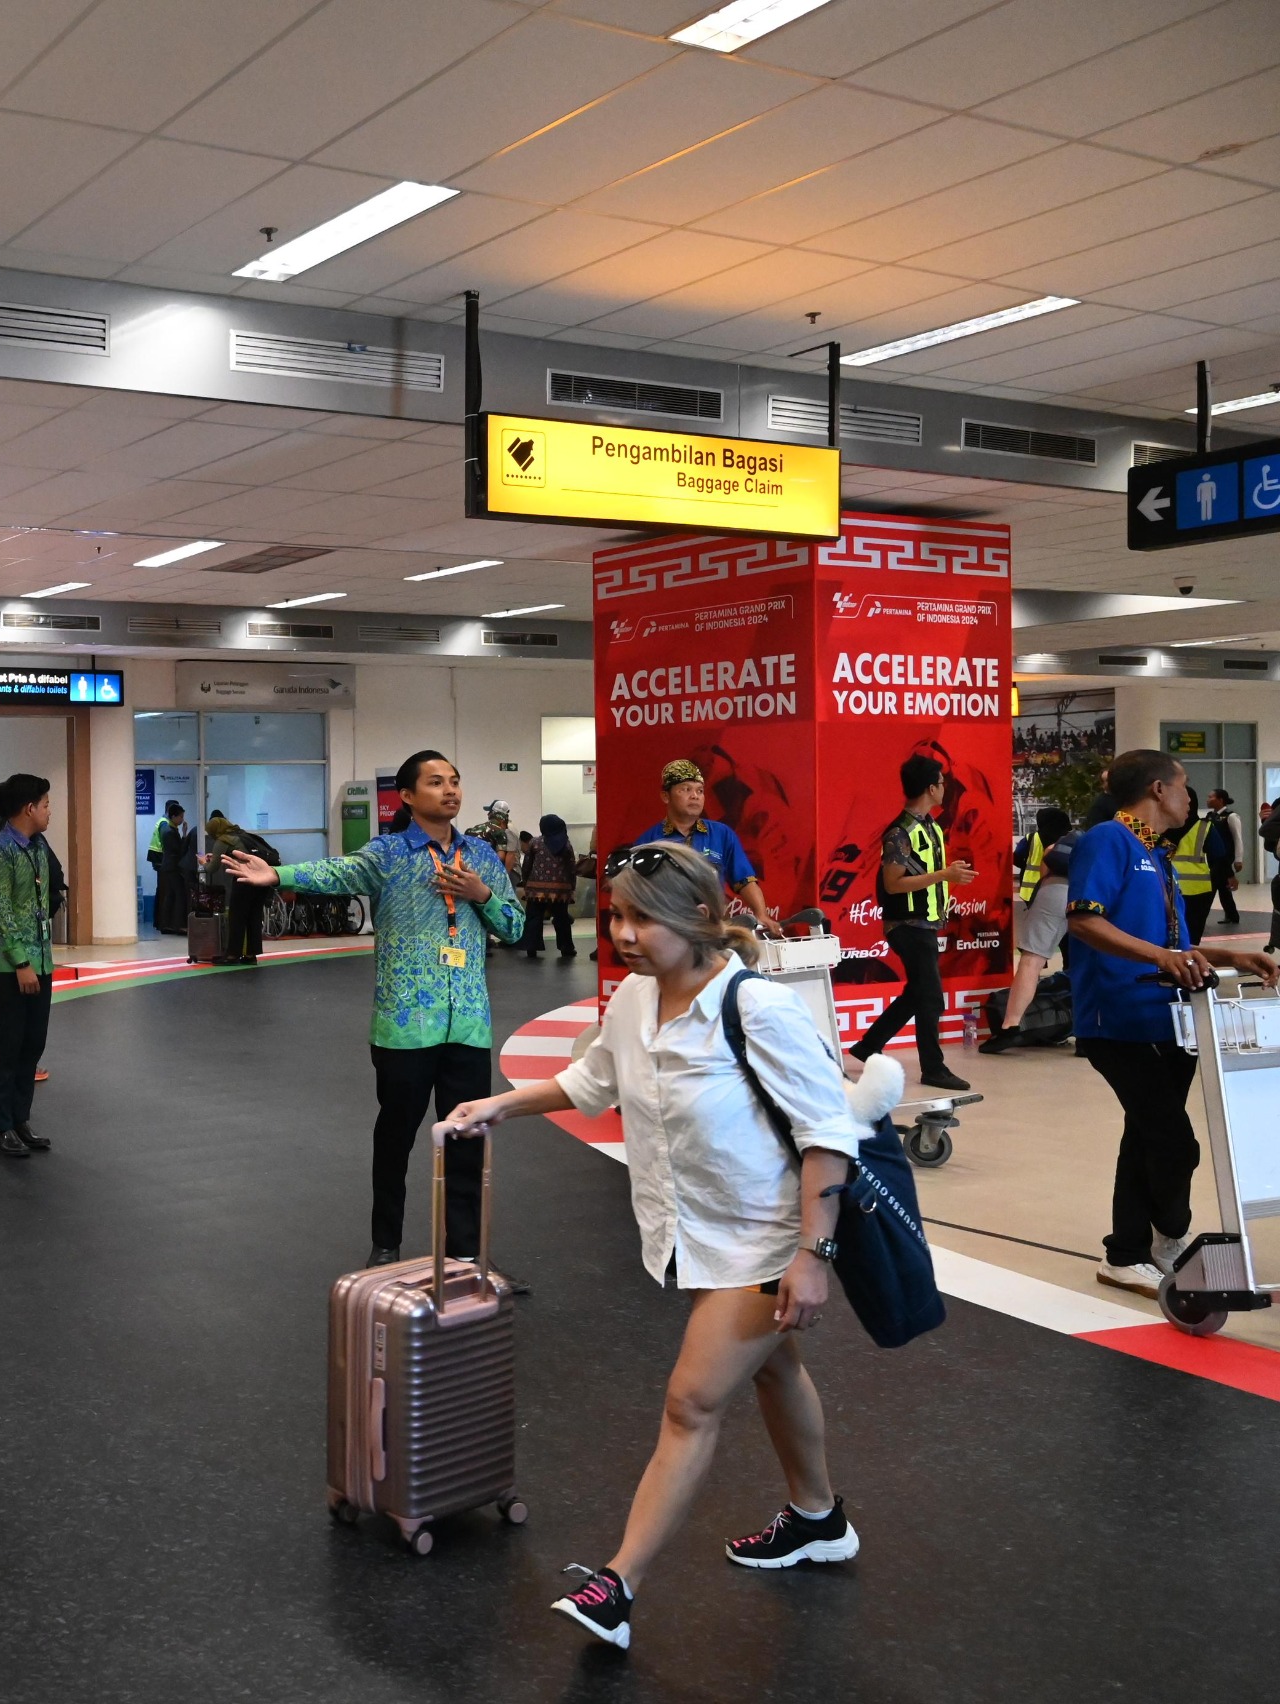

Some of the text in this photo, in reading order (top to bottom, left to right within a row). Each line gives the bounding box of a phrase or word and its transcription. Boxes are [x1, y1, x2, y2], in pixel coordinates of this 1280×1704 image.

[592, 436, 784, 475] Pengambilan Bagasi
[677, 472, 783, 495] Baggage Claim
[695, 600, 786, 621] PERTAMINA GRAND PRIX
[883, 608, 912, 616] PERTAMINA
[917, 602, 992, 615] PERTAMINA GRAND PRIX
[695, 615, 768, 632] OF INDONESIA 2024
[917, 614, 978, 625] OF INDONESIA 2024
[658, 622, 690, 632] PERTAMINA
[832, 652, 999, 688] ACCELERATE
[29, 673, 36, 684] &
[38, 674, 68, 684] difabel
[610, 653, 796, 701] ACCELERATE
[13, 685, 19, 694] &
[47, 686, 68, 695] toilets
[273, 685, 329, 695] Garuda Indonesia
[610, 691, 796, 728] YOUR EMOTION
[832, 690, 999, 717] YOUR EMOTION
[956, 938, 1000, 950] Enduro
[841, 949, 881, 959] URBO
